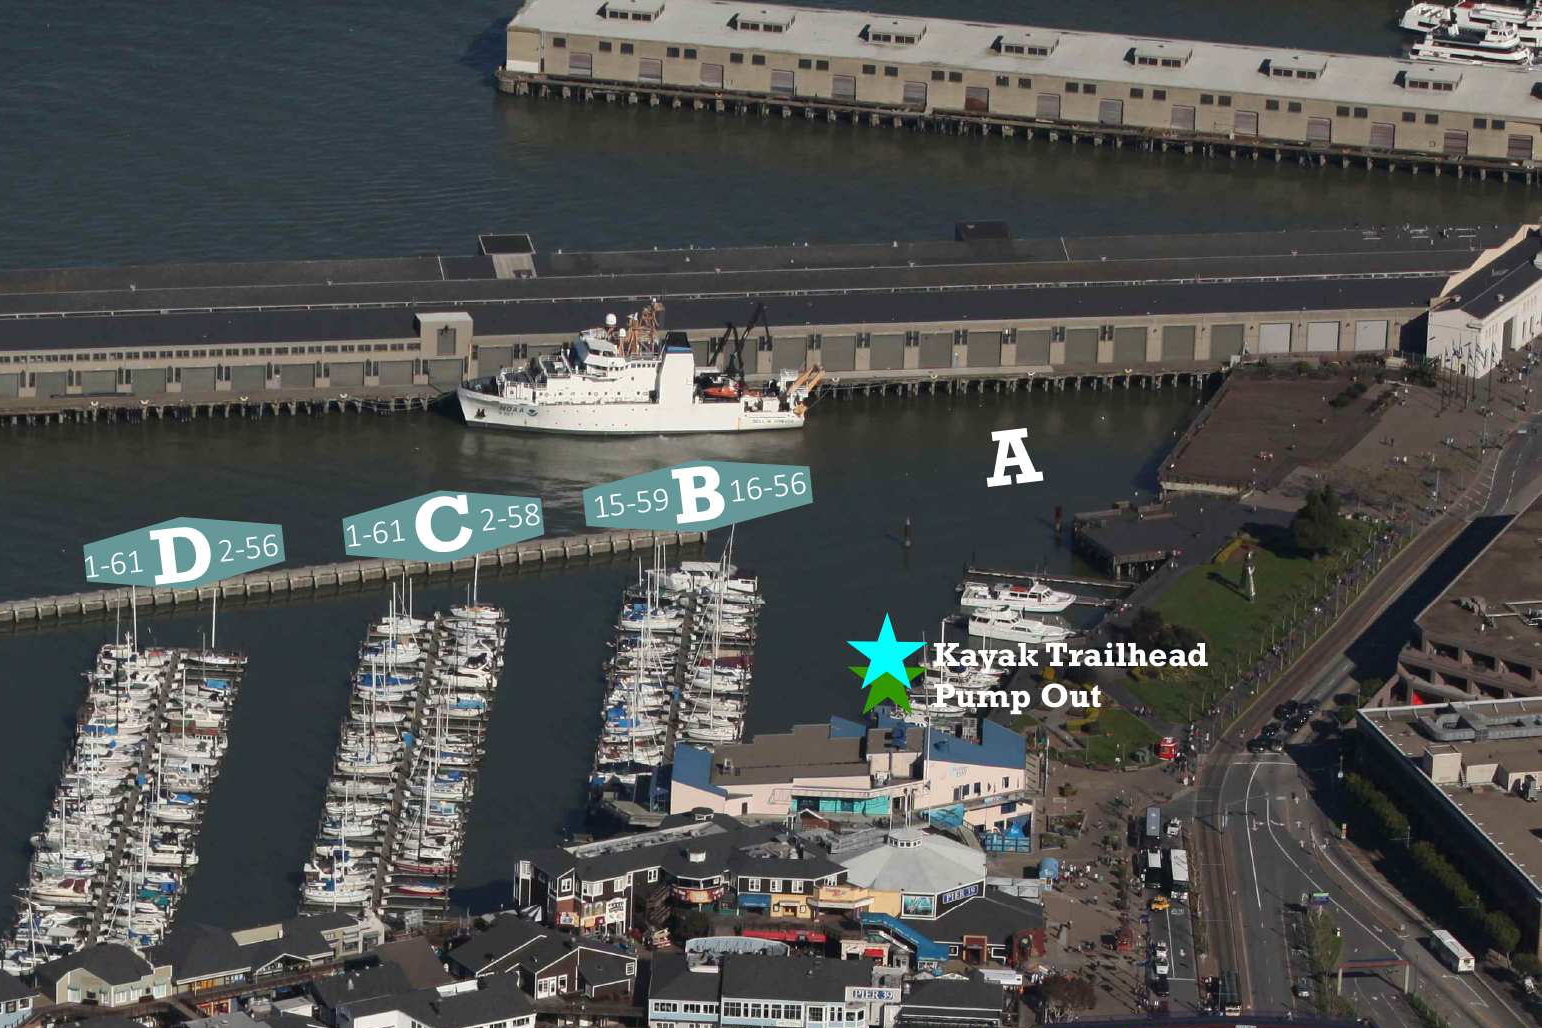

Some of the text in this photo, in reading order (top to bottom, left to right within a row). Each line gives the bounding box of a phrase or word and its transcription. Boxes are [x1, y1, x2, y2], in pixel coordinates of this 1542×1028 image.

[499, 405, 525, 413] NOAA
[945, 886, 978, 903] PIER 39
[853, 989, 894, 1000] PIER 39
